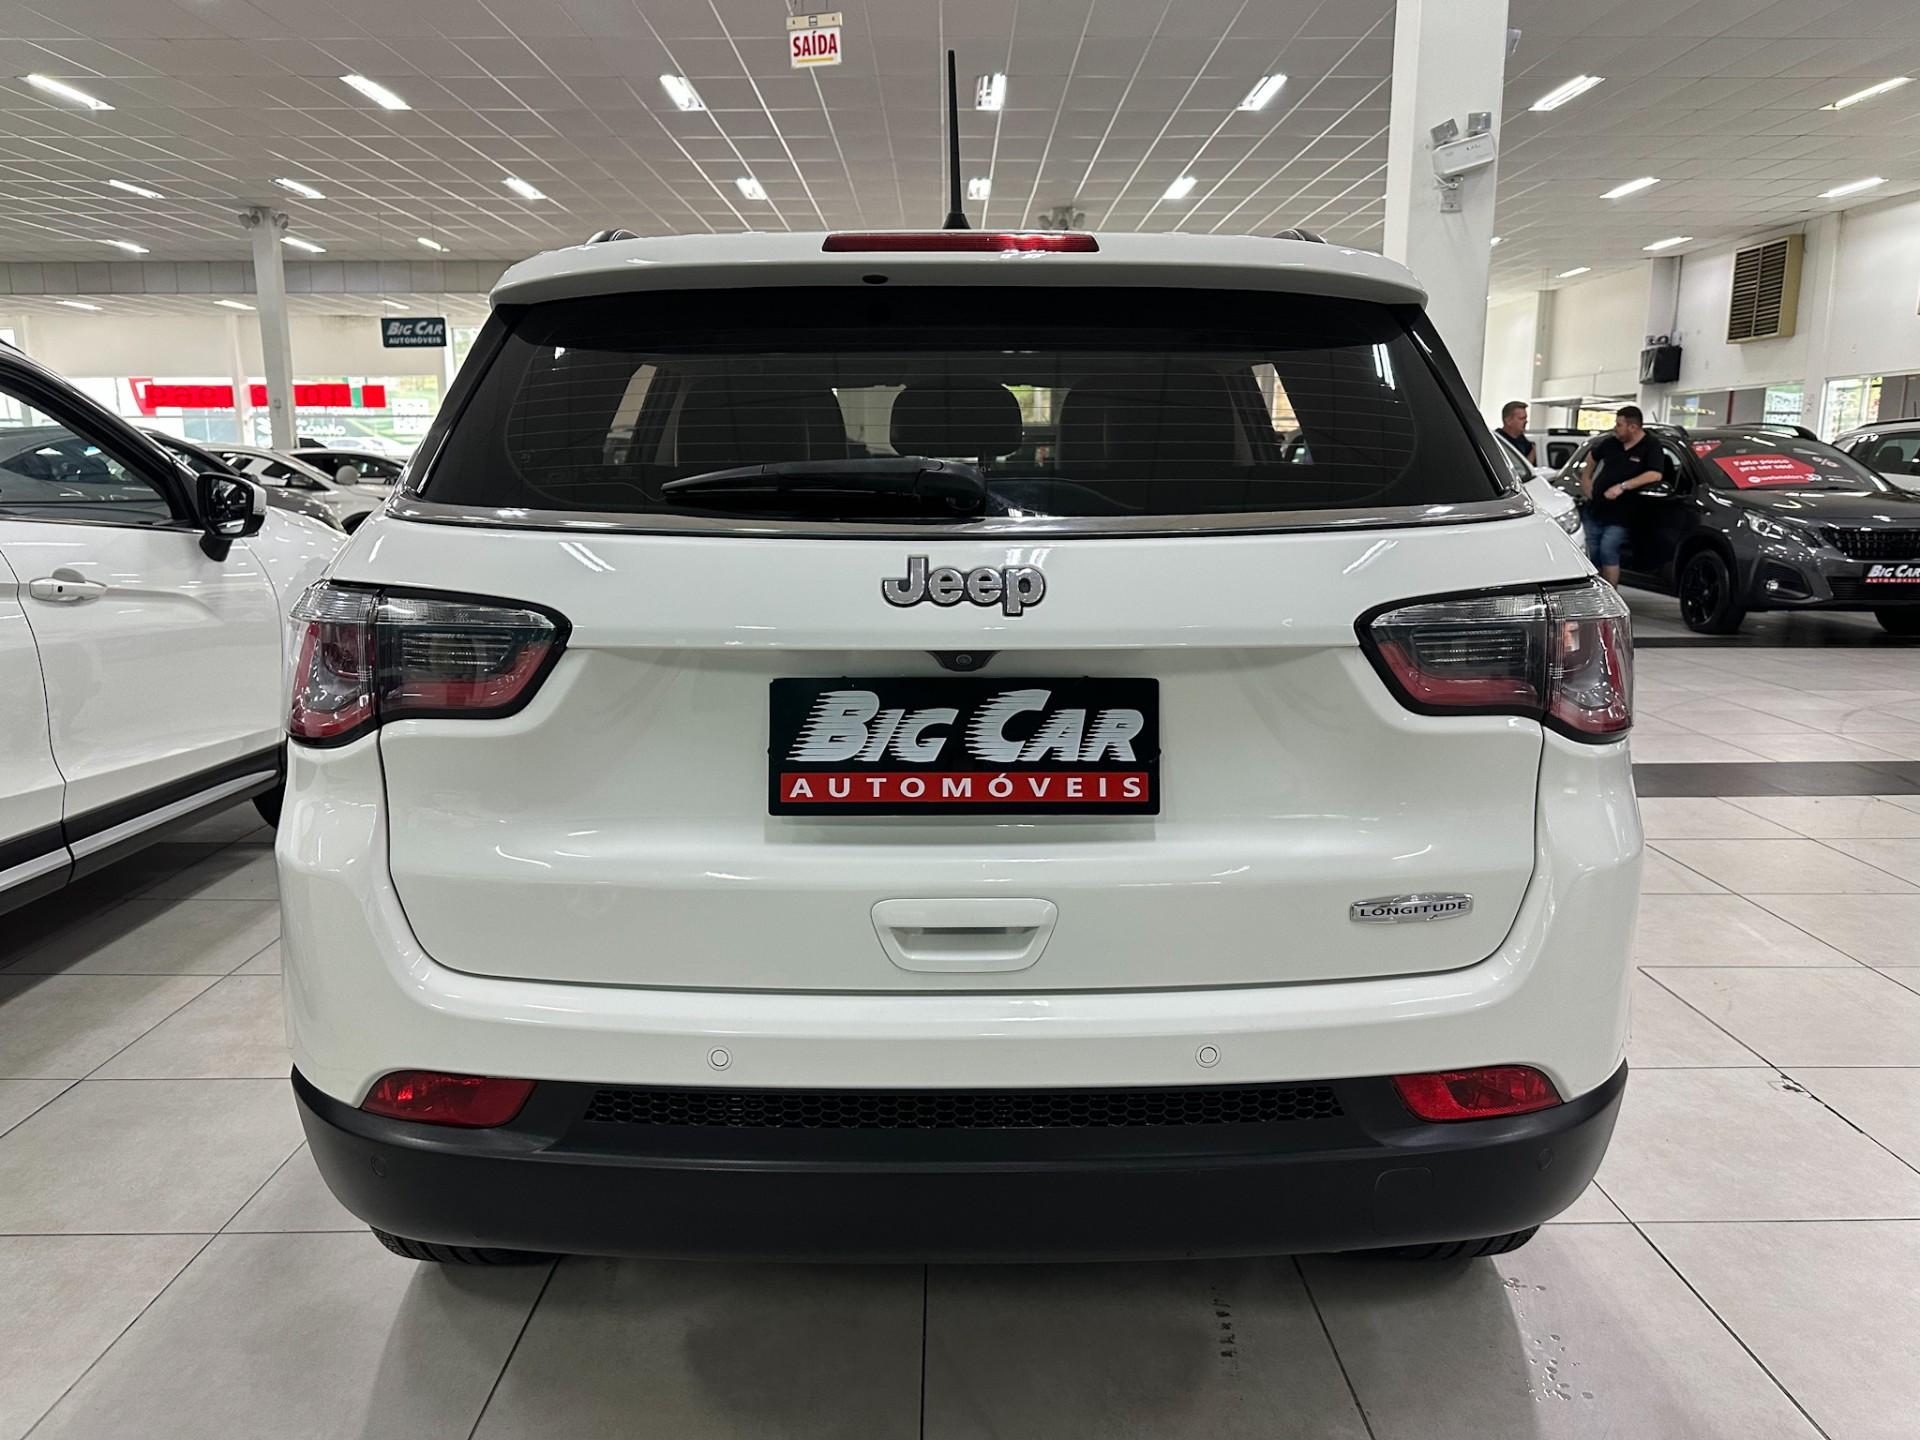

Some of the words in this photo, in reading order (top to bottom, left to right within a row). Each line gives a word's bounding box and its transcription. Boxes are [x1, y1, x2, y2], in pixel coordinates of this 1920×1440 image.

[793, 31, 838, 57] SAÍDA
[387, 322, 413, 335] BIG
[415, 321, 443, 335] CAR
[1868, 564, 1895, 577] BIG
[1895, 564, 1920, 577] CAR
[881, 555, 1046, 617] Jeep
[785, 690, 959, 763] BIG
[964, 689, 1145, 763] CAR
[789, 773, 1142, 798] AUTOMÓVEIS
[1360, 901, 1467, 917] LONGITUDE
